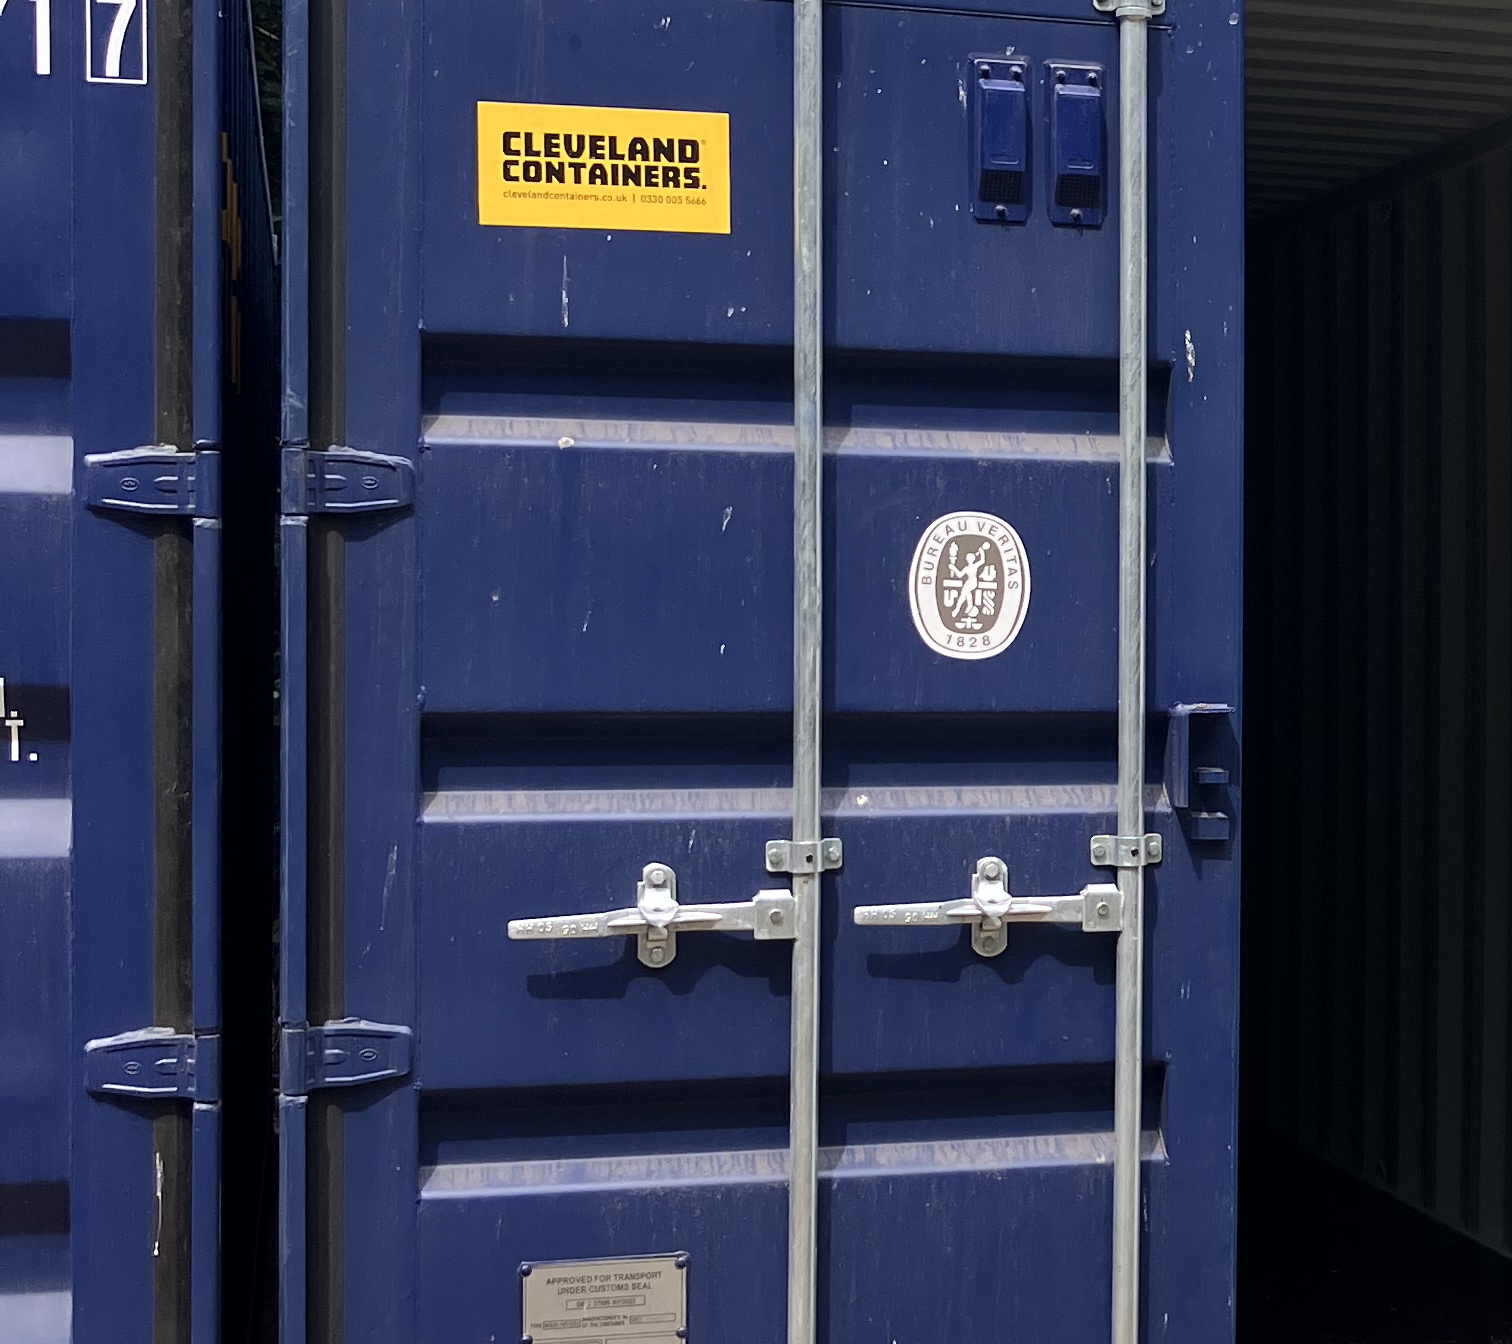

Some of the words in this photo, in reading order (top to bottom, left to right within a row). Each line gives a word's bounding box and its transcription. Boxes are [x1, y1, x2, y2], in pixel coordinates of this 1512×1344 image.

[502, 131, 700, 164] CLEVELAND
[502, 159, 707, 190] CONTAINERS.
[503, 189, 628, 203] clevelandcontainers.co.uk
[640, 194, 664, 204] 0330
[685, 196, 707, 206] 5666
[921, 520, 968, 586] BUREAU
[976, 520, 1019, 591] VERITAS
[946, 634, 991, 648] 1828
[546, 1273, 593, 1286] APPROVED
[594, 1273, 612, 1283] FOR
[613, 1271, 662, 1282] TRANSPORT
[557, 1285, 587, 1295] UNDER
[589, 1283, 630, 1293] CUSTOMS
[632, 1282, 653, 1292] SEAL
